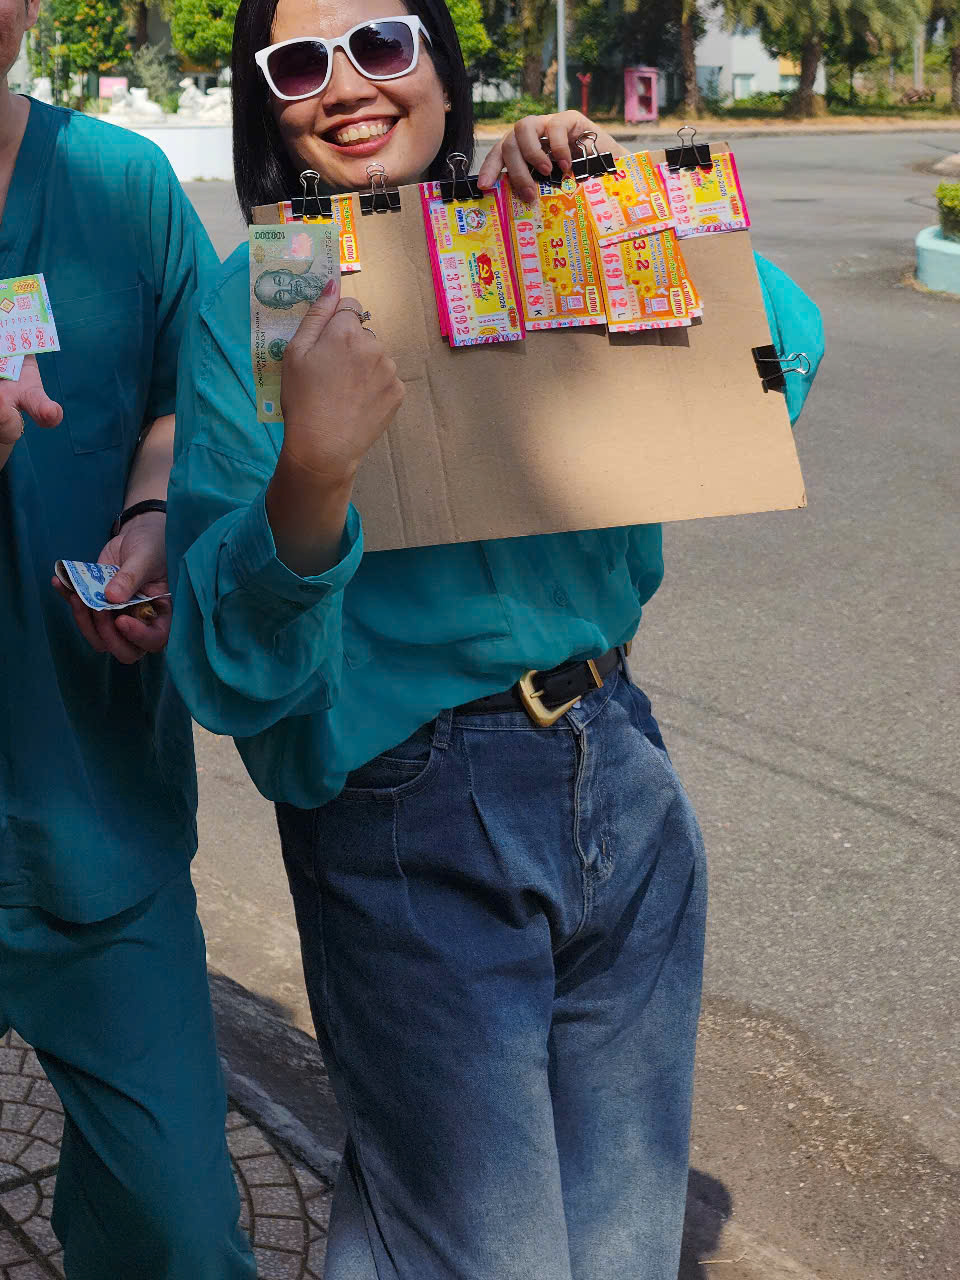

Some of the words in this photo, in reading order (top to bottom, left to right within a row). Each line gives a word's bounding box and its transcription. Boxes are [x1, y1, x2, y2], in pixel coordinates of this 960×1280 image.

[712, 158, 727, 197] 04-02-2026
[604, 224, 613, 232] X
[515, 219, 545, 307] 631148
[548, 236, 567, 270] 3-2
[632, 238, 650, 271] 3-2
[444, 271, 471, 336] 374092
[492, 270, 507, 309] 04-02-2026
[586, 286, 598, 313] 10.000đ
[671, 288, 683, 315] 10.000đ
